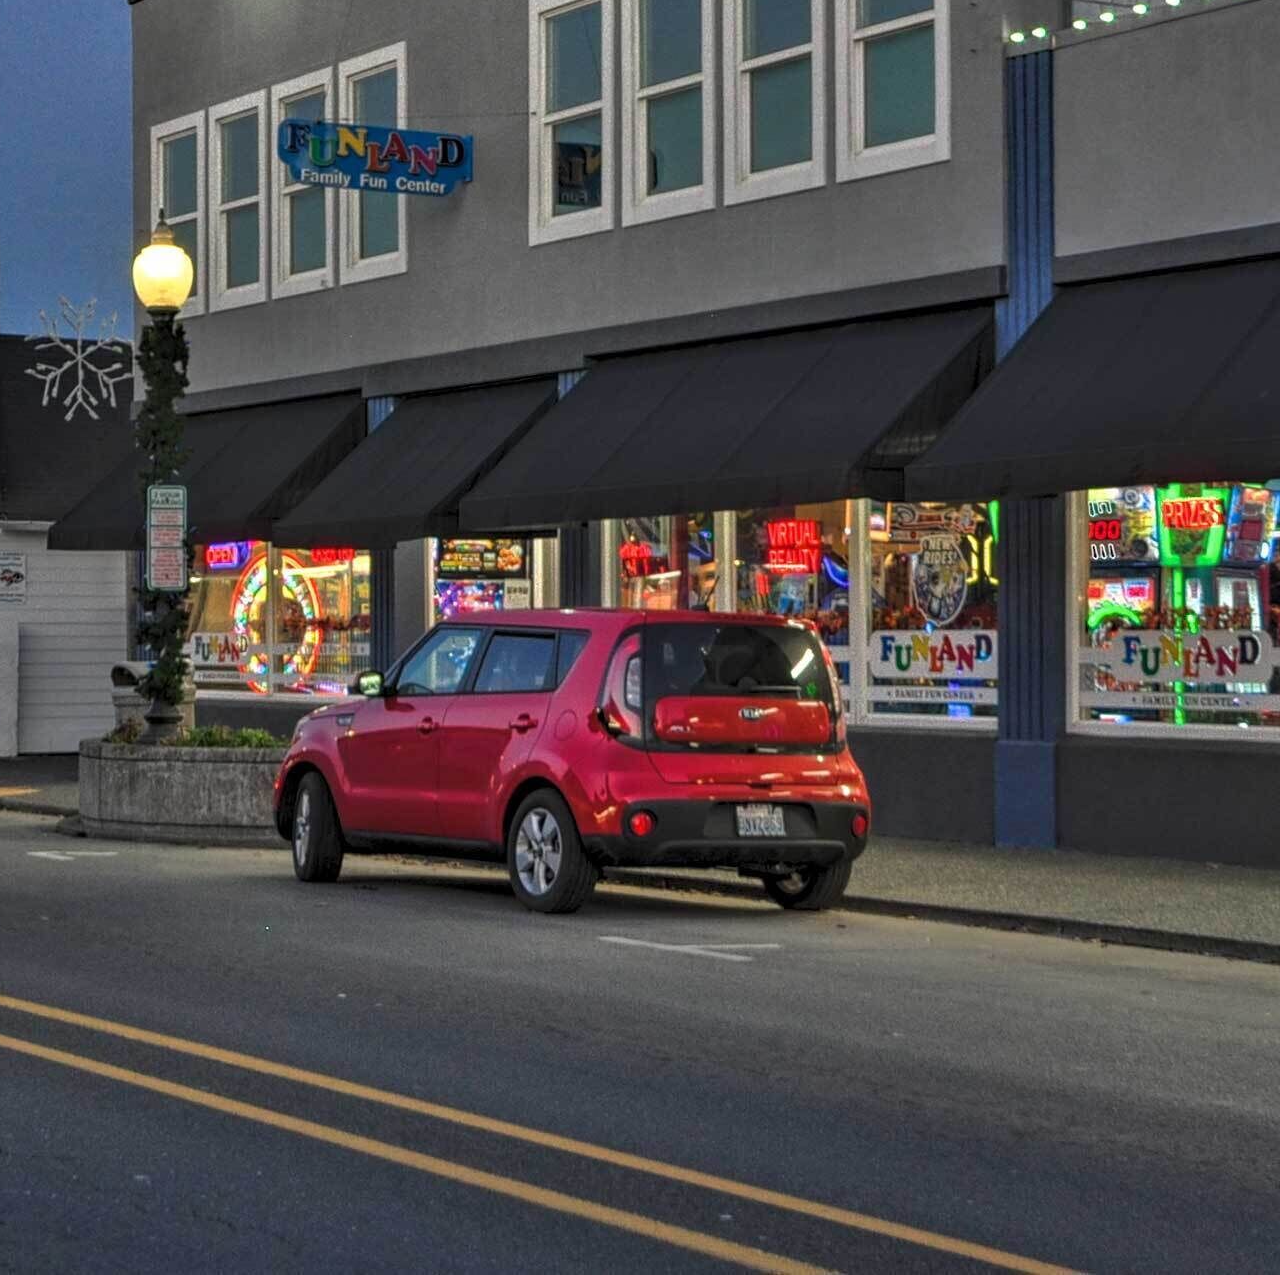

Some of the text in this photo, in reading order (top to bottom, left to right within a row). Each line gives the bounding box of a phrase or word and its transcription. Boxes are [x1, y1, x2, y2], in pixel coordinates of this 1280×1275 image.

[285, 122, 466, 175] FUNLAND
[300, 168, 446, 195] Family Fun Center
[1161, 495, 1224, 529] PRIZES
[768, 521, 818, 545] VIRTUAL
[206, 547, 236, 564] OPEN
[880, 634, 993, 673] FUNLAND
[1122, 635, 1261, 677] FUNLAND
